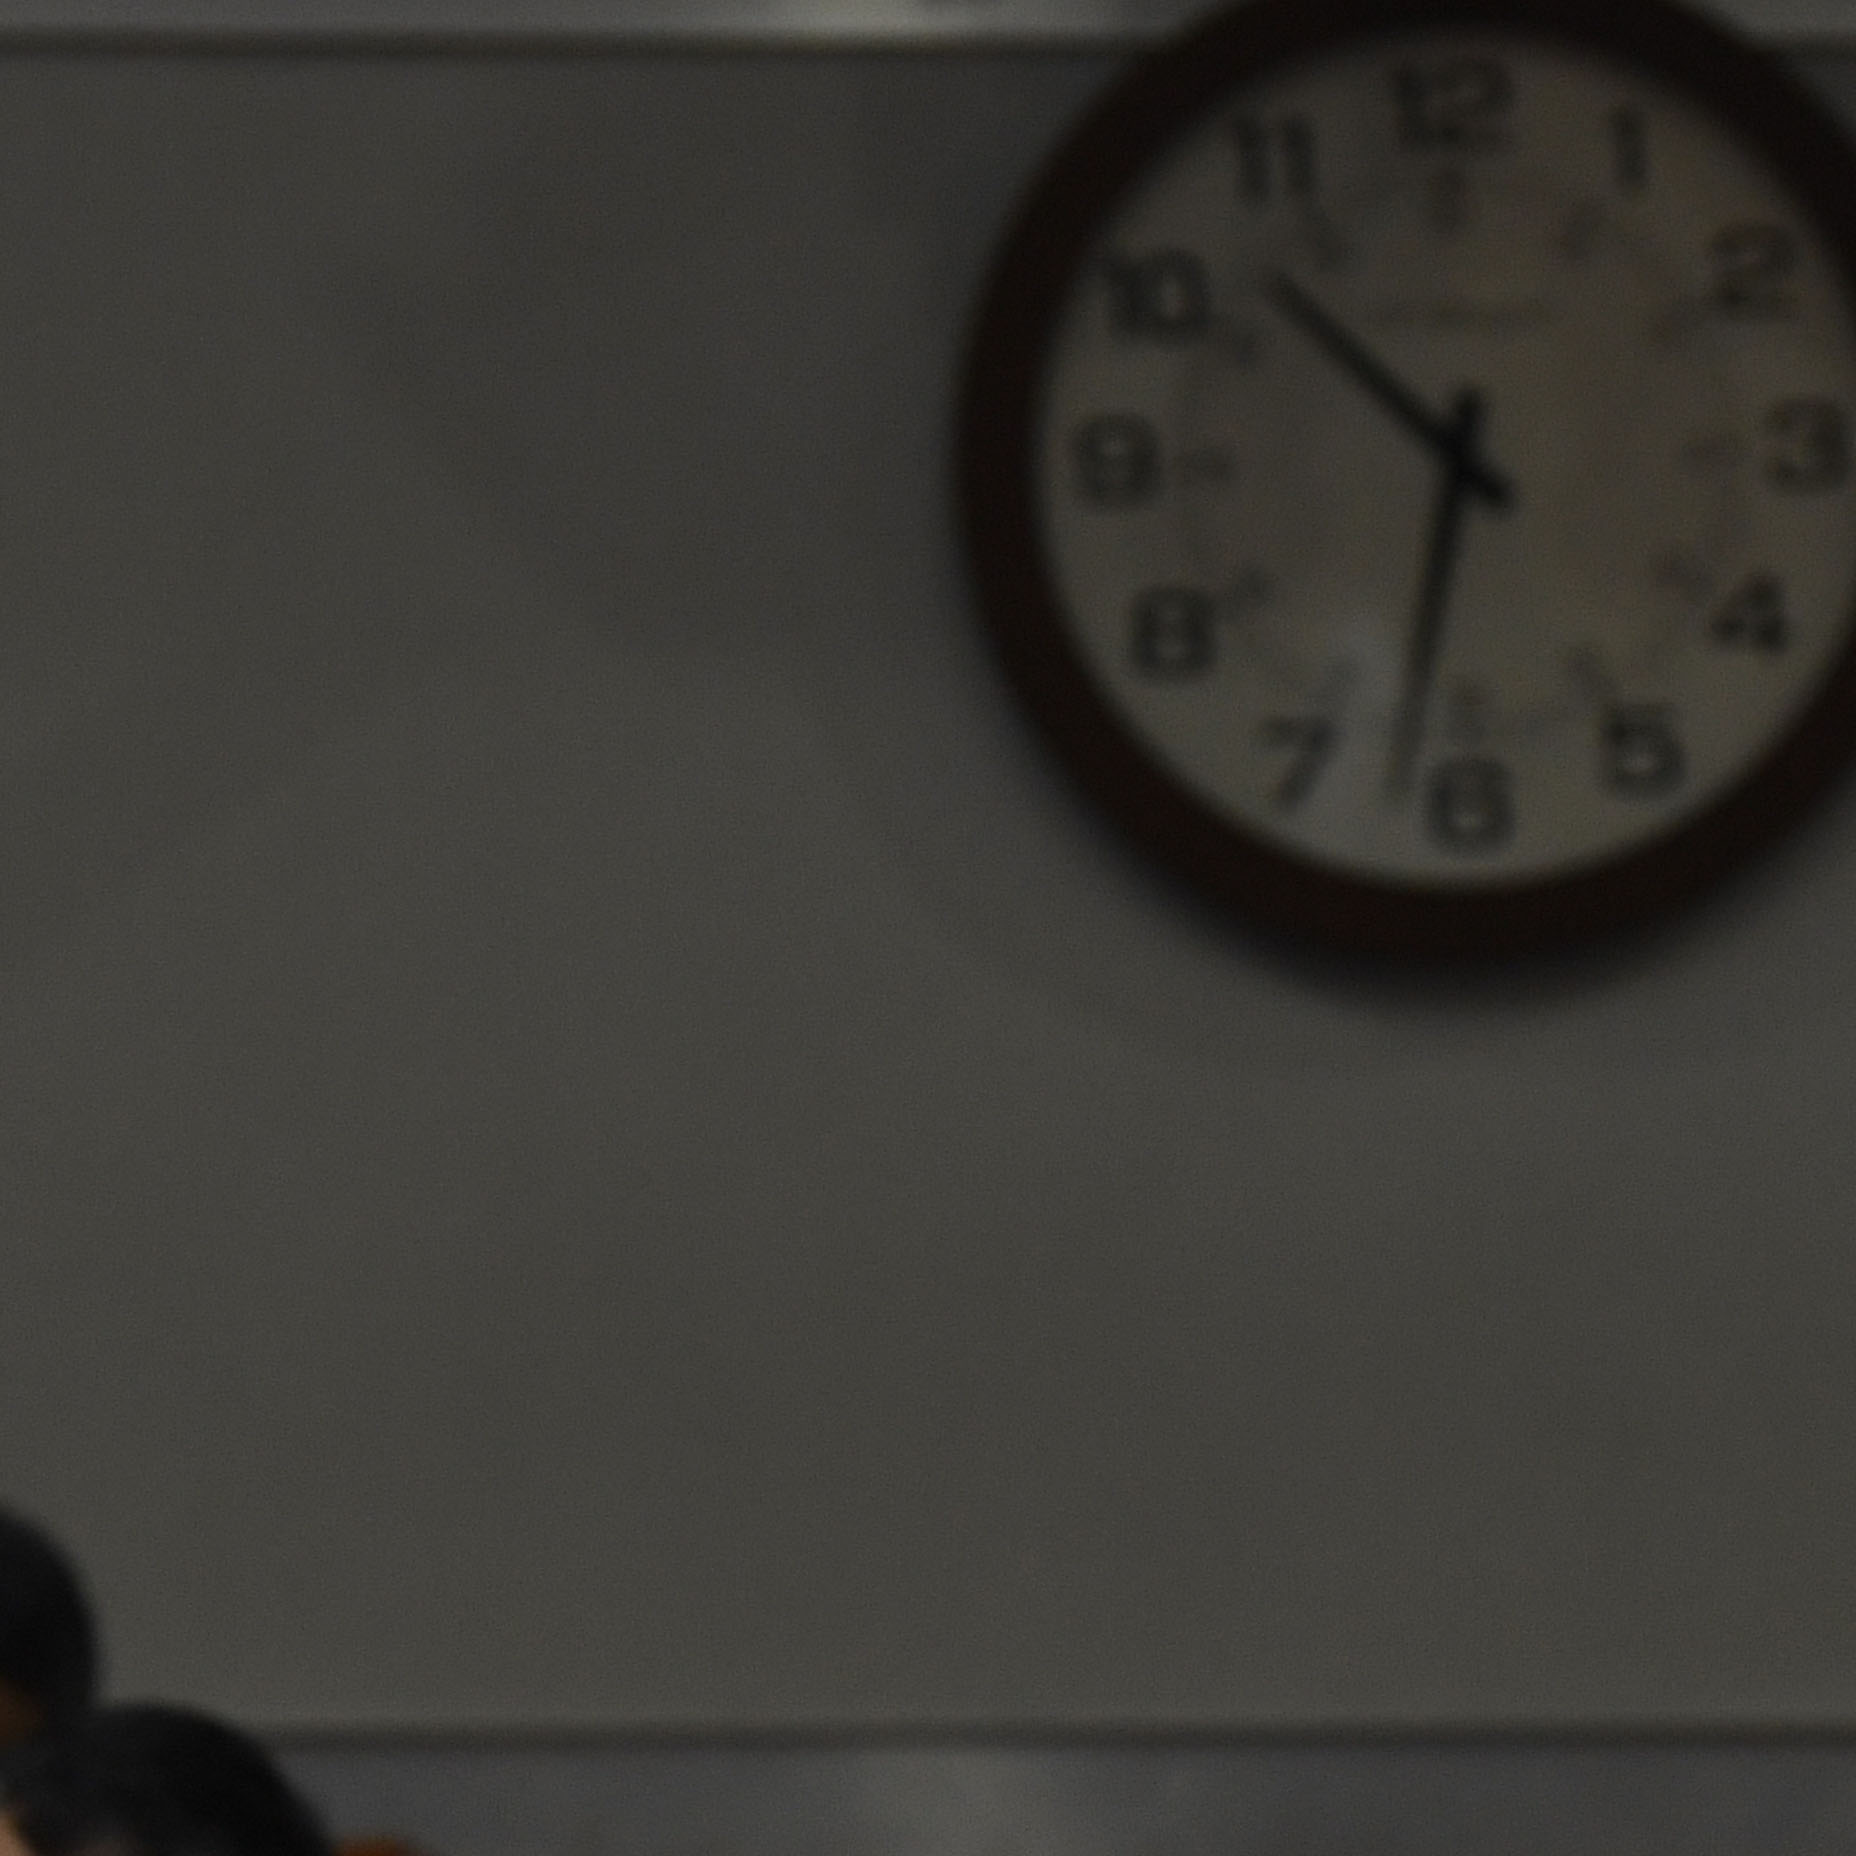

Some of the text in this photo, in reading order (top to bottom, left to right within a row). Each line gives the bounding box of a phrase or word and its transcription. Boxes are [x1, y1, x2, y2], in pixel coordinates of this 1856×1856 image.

[1391, 56, 1515, 154] 12
[1609, 103, 1649, 189] 1
[1231, 114, 1321, 201] 11
[1104, 246, 1212, 345] 10
[1710, 223, 1797, 321] 2
[1073, 412, 1160, 509] 9
[1764, 400, 1854, 496] 3
[1132, 587, 1216, 682] 8
[1710, 574, 1790, 654] 4
[1258, 713, 1334, 812] 7
[1600, 701, 1686, 796] 5
[1425, 756, 1515, 853] 6
